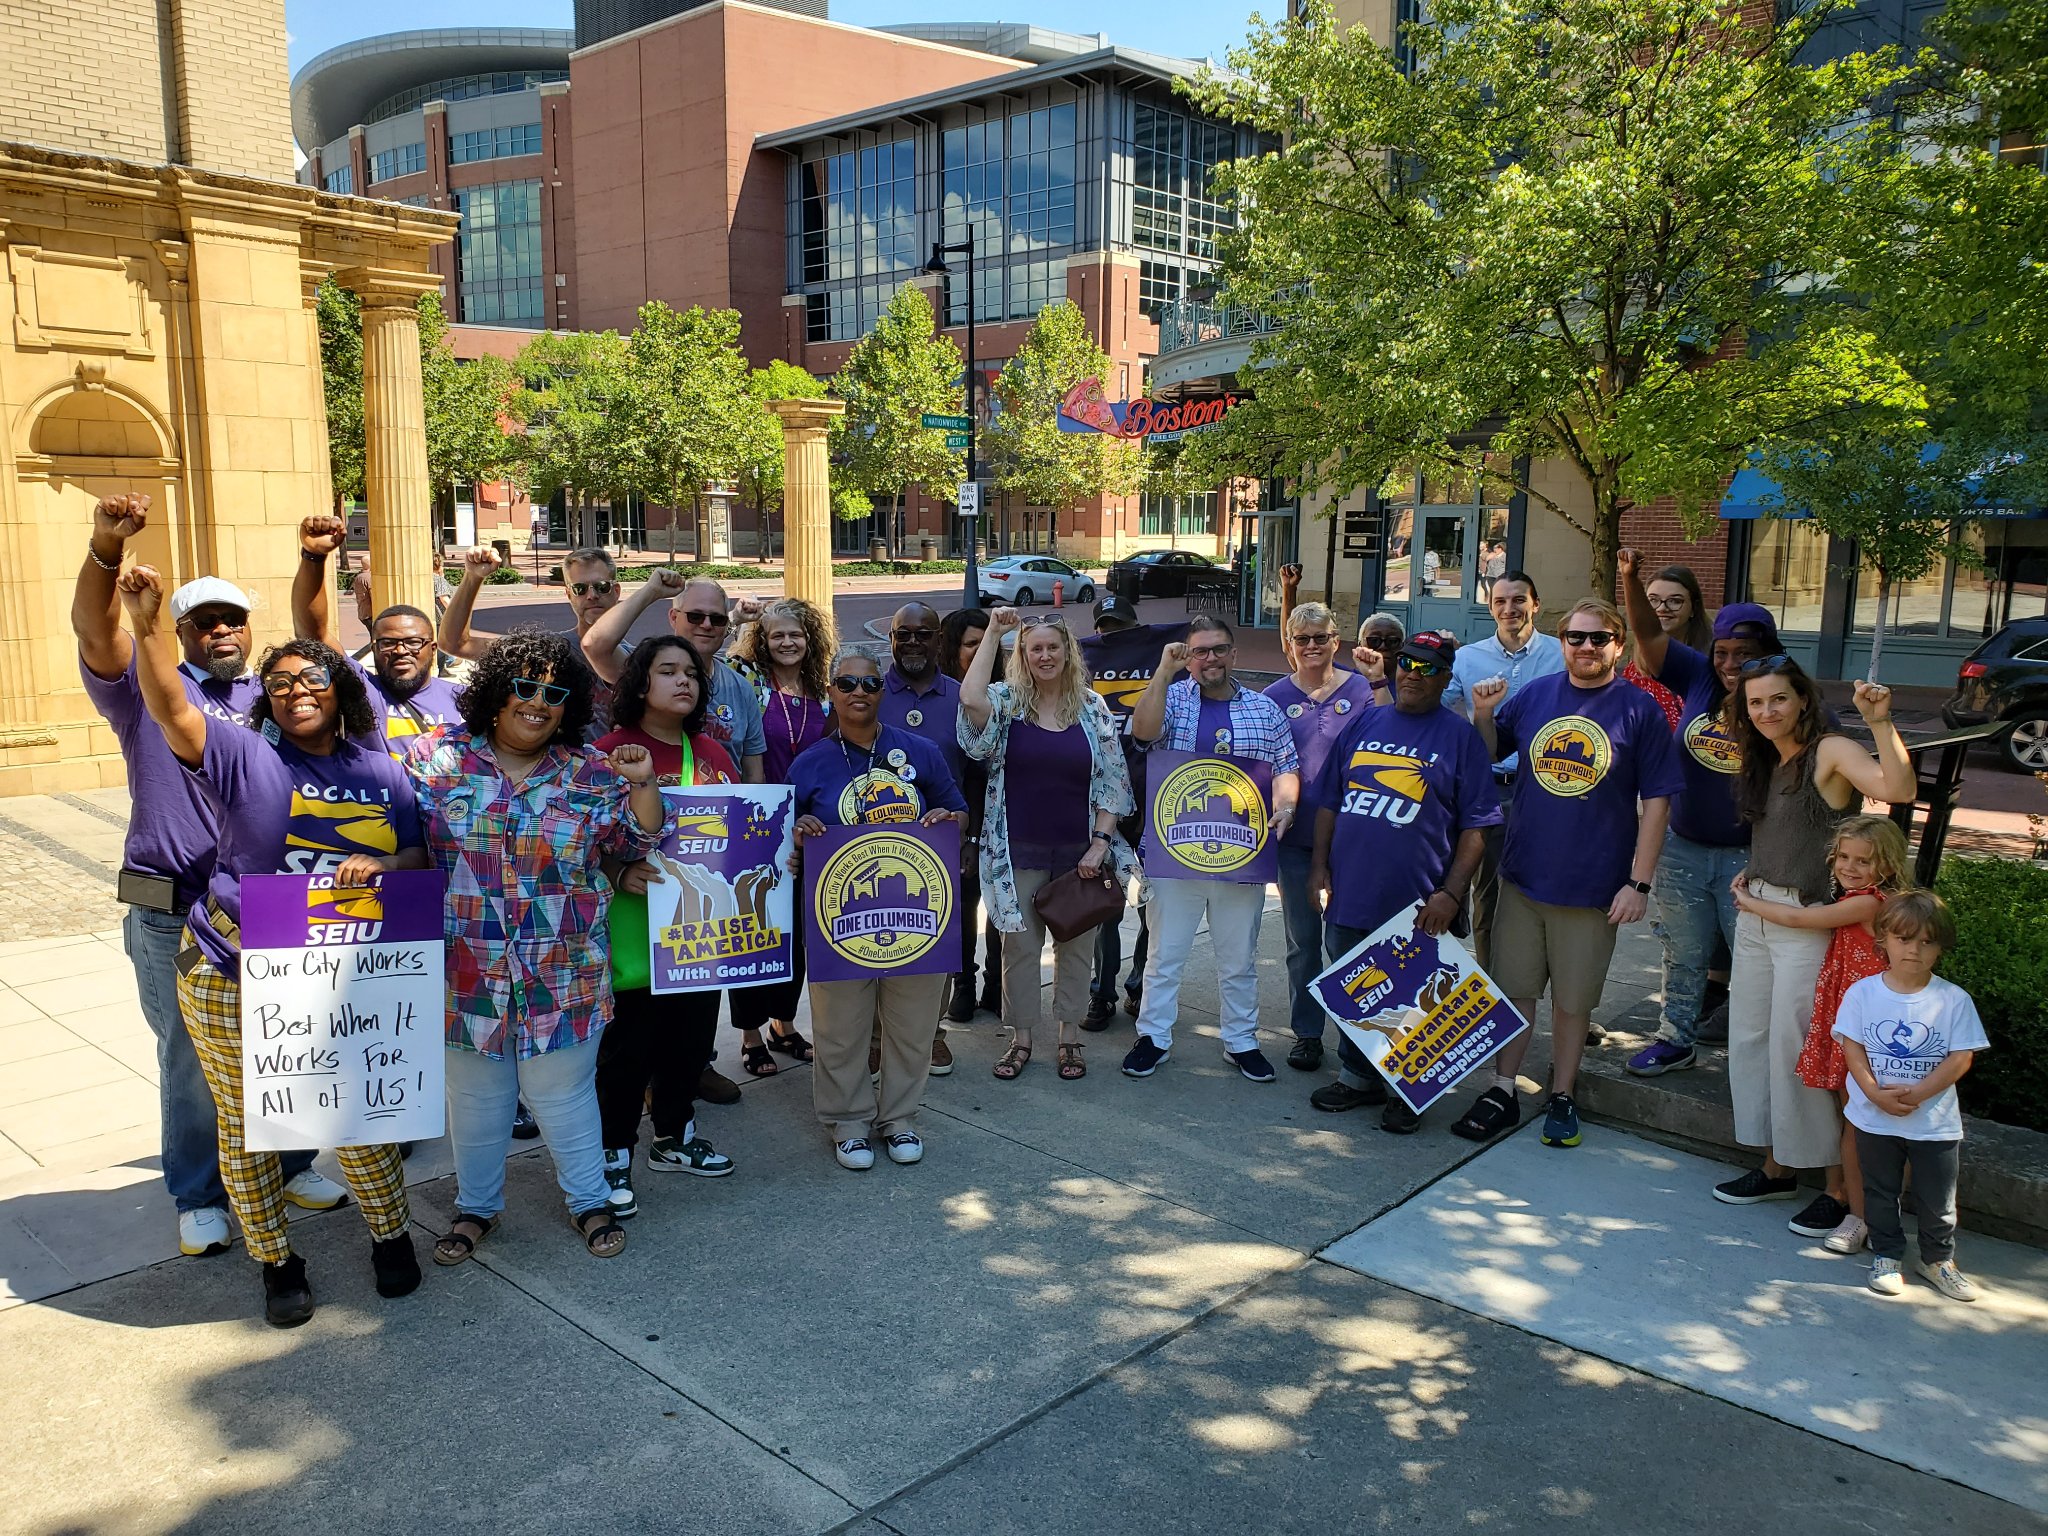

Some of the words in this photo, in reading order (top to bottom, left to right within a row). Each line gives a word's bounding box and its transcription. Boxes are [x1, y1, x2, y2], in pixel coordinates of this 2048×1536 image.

[927, 417, 959, 428] NATIONWIDE
[1120, 391, 1237, 439] Boston's
[948, 438, 961, 446] WEST
[961, 485, 975, 493] ONE
[1094, 669, 1151, 681] LOCAL
[1693, 737, 1709, 747] ONE
[1356, 740, 1418, 758] LOCAL
[1429, 753, 1439, 763] 1
[1185, 771, 1201, 782] Best
[1200, 768, 1219, 777] When
[1219, 770, 1225, 778] It
[1539, 759, 1553, 770] ONE
[1554, 761, 1594, 780] COLUMBUS
[1170, 779, 1188, 795] Works
[1225, 772, 1243, 788] Works
[294, 783, 372, 803] OCAL
[380, 788, 390, 802] 1
[1165, 794, 1176, 807] City
[678, 805, 719, 816] LOCAL
[722, 805, 729, 815] 1
[873, 804, 914, 820] COLUMBUS
[1164, 808, 1173, 818] Our
[1340, 790, 1422, 825] SEIU
[1171, 826, 1193, 841] ONE
[1194, 824, 1253, 844] COLUMBUS
[677, 838, 729, 855] SEIU
[869, 844, 890, 856] When
[892, 845, 898, 854] It
[898, 846, 919, 863] Works
[851, 850, 869, 863] Best
[1188, 850, 1236, 865] #OneColumbus
[833, 860, 854, 882] Works
[917, 859, 929, 871] for
[374, 875, 383, 887] 1
[924, 869, 936, 884] ALL
[828, 879, 842, 895] City
[930, 884, 939, 892] of
[828, 896, 838, 910] Our
[930, 892, 941, 903] Us
[667, 915, 755, 942] #RAISE
[837, 915, 862, 936] ONE
[864, 911, 932, 930] COLUMBUS
[305, 921, 383, 946] SEIU
[676, 929, 779, 962] AMERICA
[858, 943, 913, 959] #OneColumbus
[246, 954, 293, 980] Our
[302, 951, 341, 991] City
[356, 948, 426, 976] Works
[667, 966, 711, 982] With
[716, 962, 757, 978] Good
[759, 960, 785, 974] Jobs
[1340, 961, 1370, 988] LOCAL
[1368, 956, 1376, 965] 1
[1358, 978, 1394, 1015] SEIU
[254, 1003, 318, 1040] Best
[330, 1003, 380, 1039] When
[395, 1002, 418, 1036] It
[1383, 986, 1470, 1073] #Levantar
[1469, 978, 1484, 994] a
[1402, 995, 1491, 1079] Columbus
[1419, 1061, 1446, 1084] con
[1443, 1018, 1497, 1063] buenos
[254, 1044, 340, 1075] Works
[1437, 1036, 1494, 1085] empleos
[1872, 1069, 1909, 1079] TESSORI
[262, 1086, 294, 1117] All
